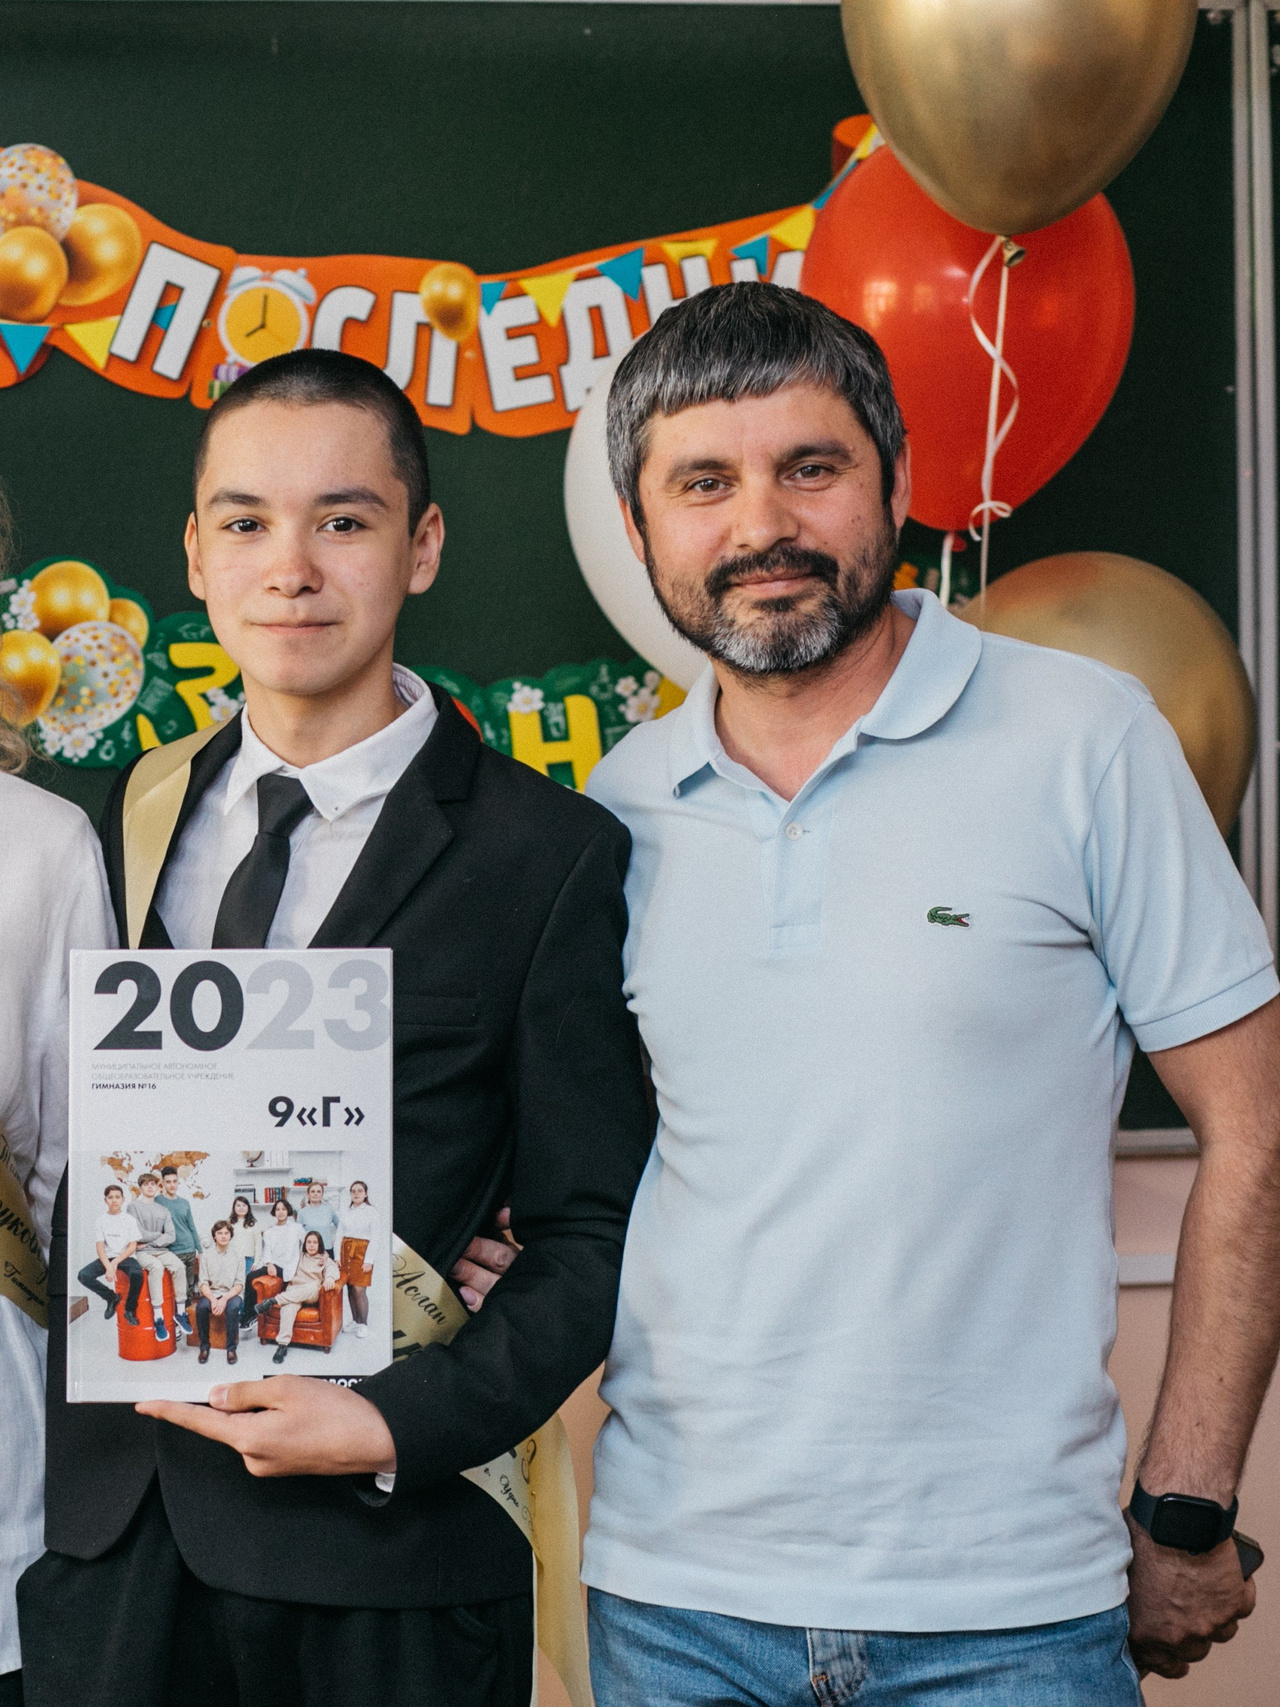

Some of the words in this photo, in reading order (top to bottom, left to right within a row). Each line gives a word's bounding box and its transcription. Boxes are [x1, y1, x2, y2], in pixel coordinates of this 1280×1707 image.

[93, 959, 391, 1051] 2023
[91, 1062, 162, 1071] МУНИЦИПАЛЬНОЕ
[163, 1062, 218, 1071] АВТОНОМНОЕ
[91, 1072, 187, 1081] ОБЩЕОБРАЗОВАТЕЛЬНОЕ
[187, 1072, 235, 1081] УЧРЕЖДЕНИЕ
[268, 1095, 365, 1128] 9«Г»
[392, 1253, 447, 1325] Аслан
